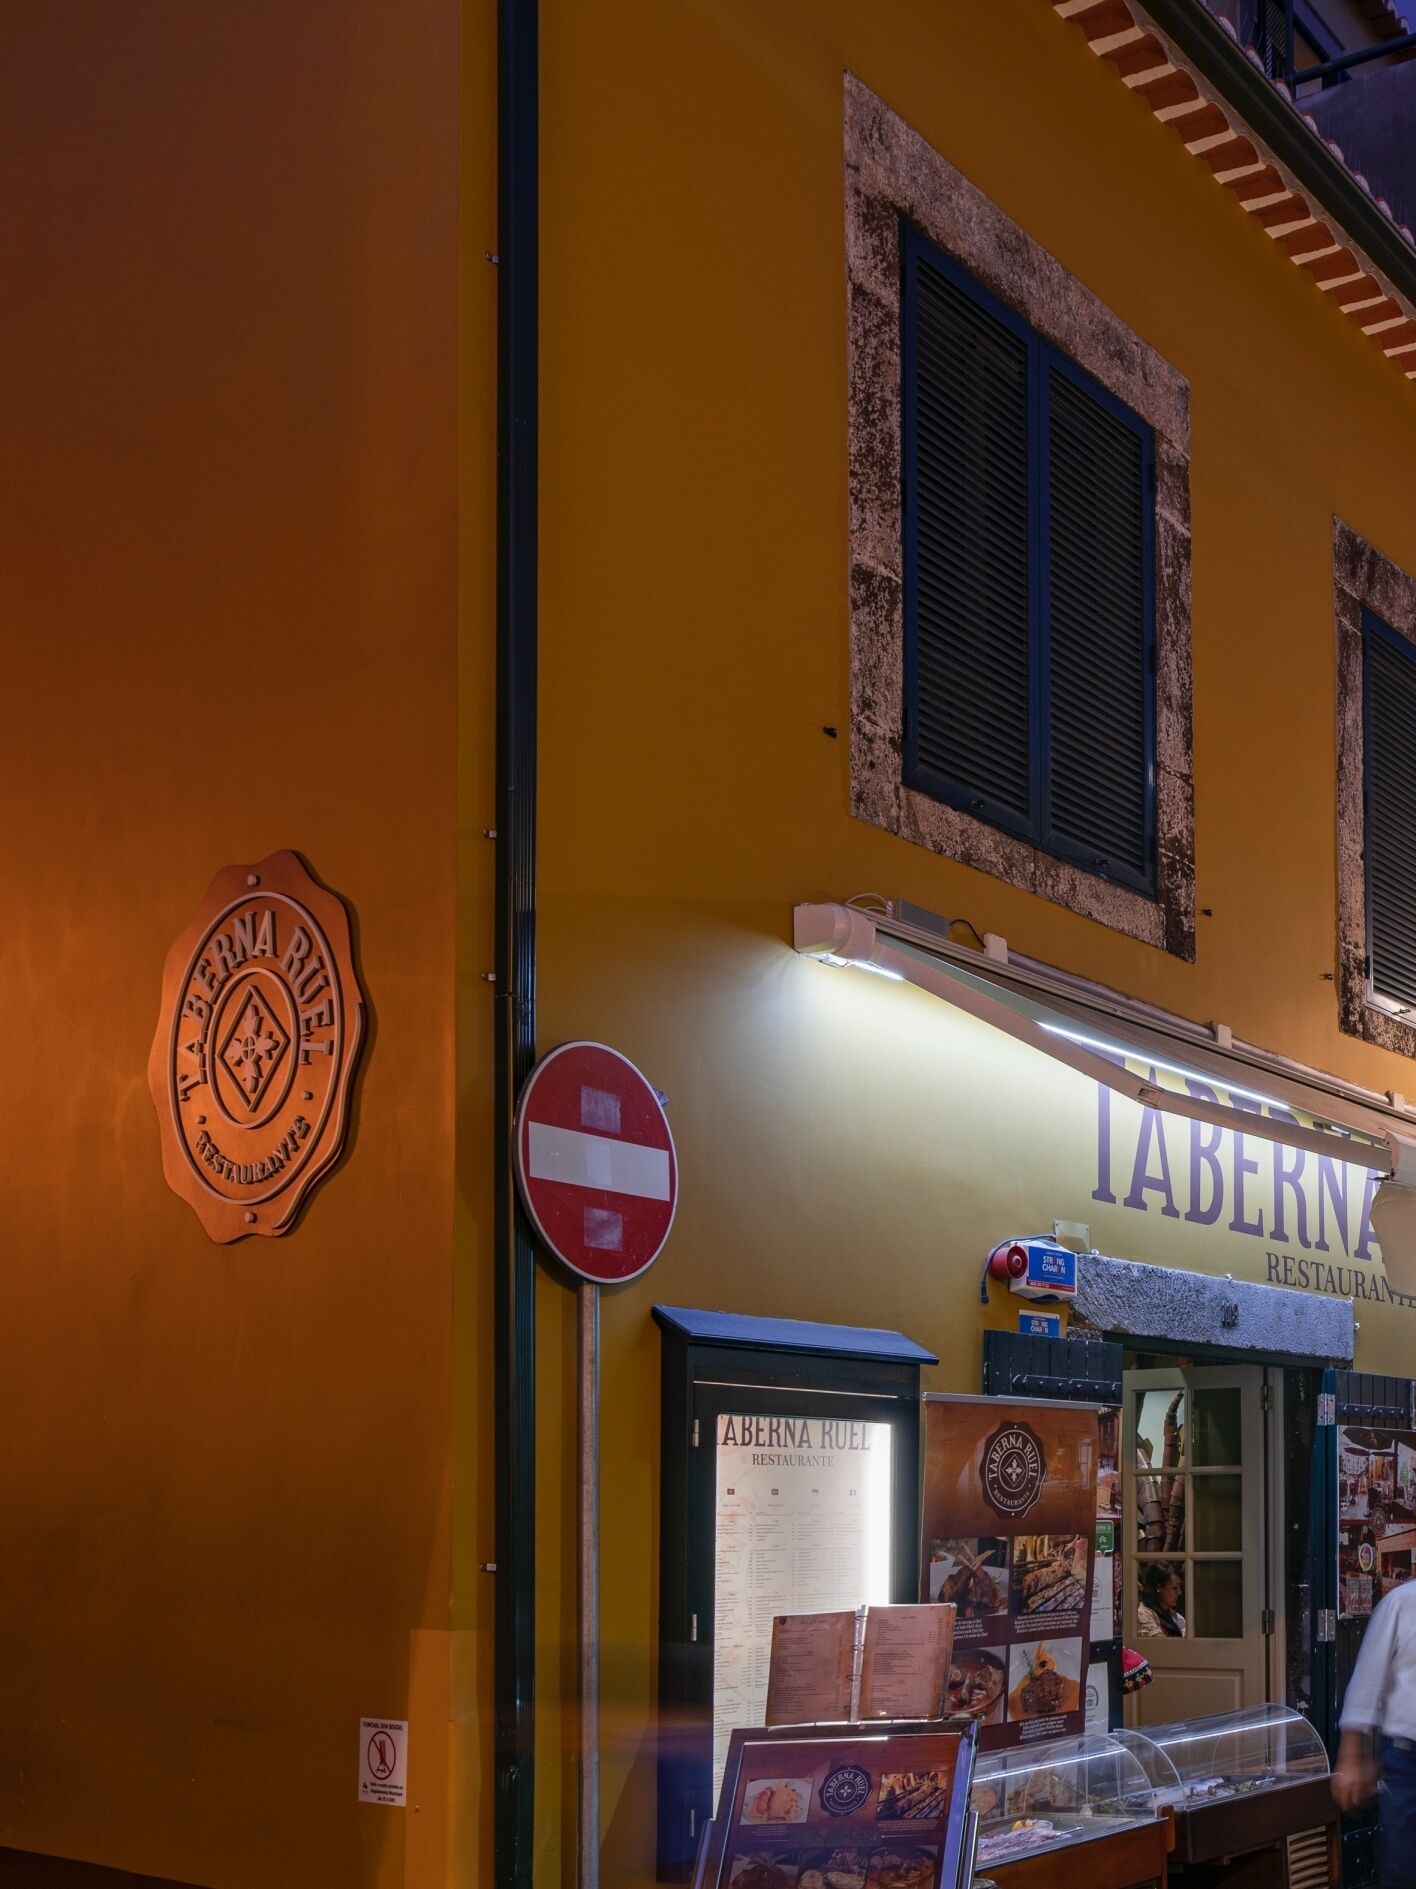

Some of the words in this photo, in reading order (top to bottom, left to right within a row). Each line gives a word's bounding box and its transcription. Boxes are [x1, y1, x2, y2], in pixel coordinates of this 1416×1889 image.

[178, 910, 279, 1103] TABERNA
[280, 925, 333, 1067] RUEL
[194, 1115, 311, 1185] RESTAURANTE
[1042, 1256, 1065, 1266] STRONG
[1042, 1264, 1066, 1274] CHARON
[821, 1421, 871, 1451] RUEL
[752, 1453, 835, 1468] RESTAURANTE
[988, 1434, 1023, 1480] TABERNA
[1023, 1443, 1038, 1479] RUEL
[993, 1488, 1030, 1507] RESTAURANTE
[826, 1772, 854, 1797] TABERNA
